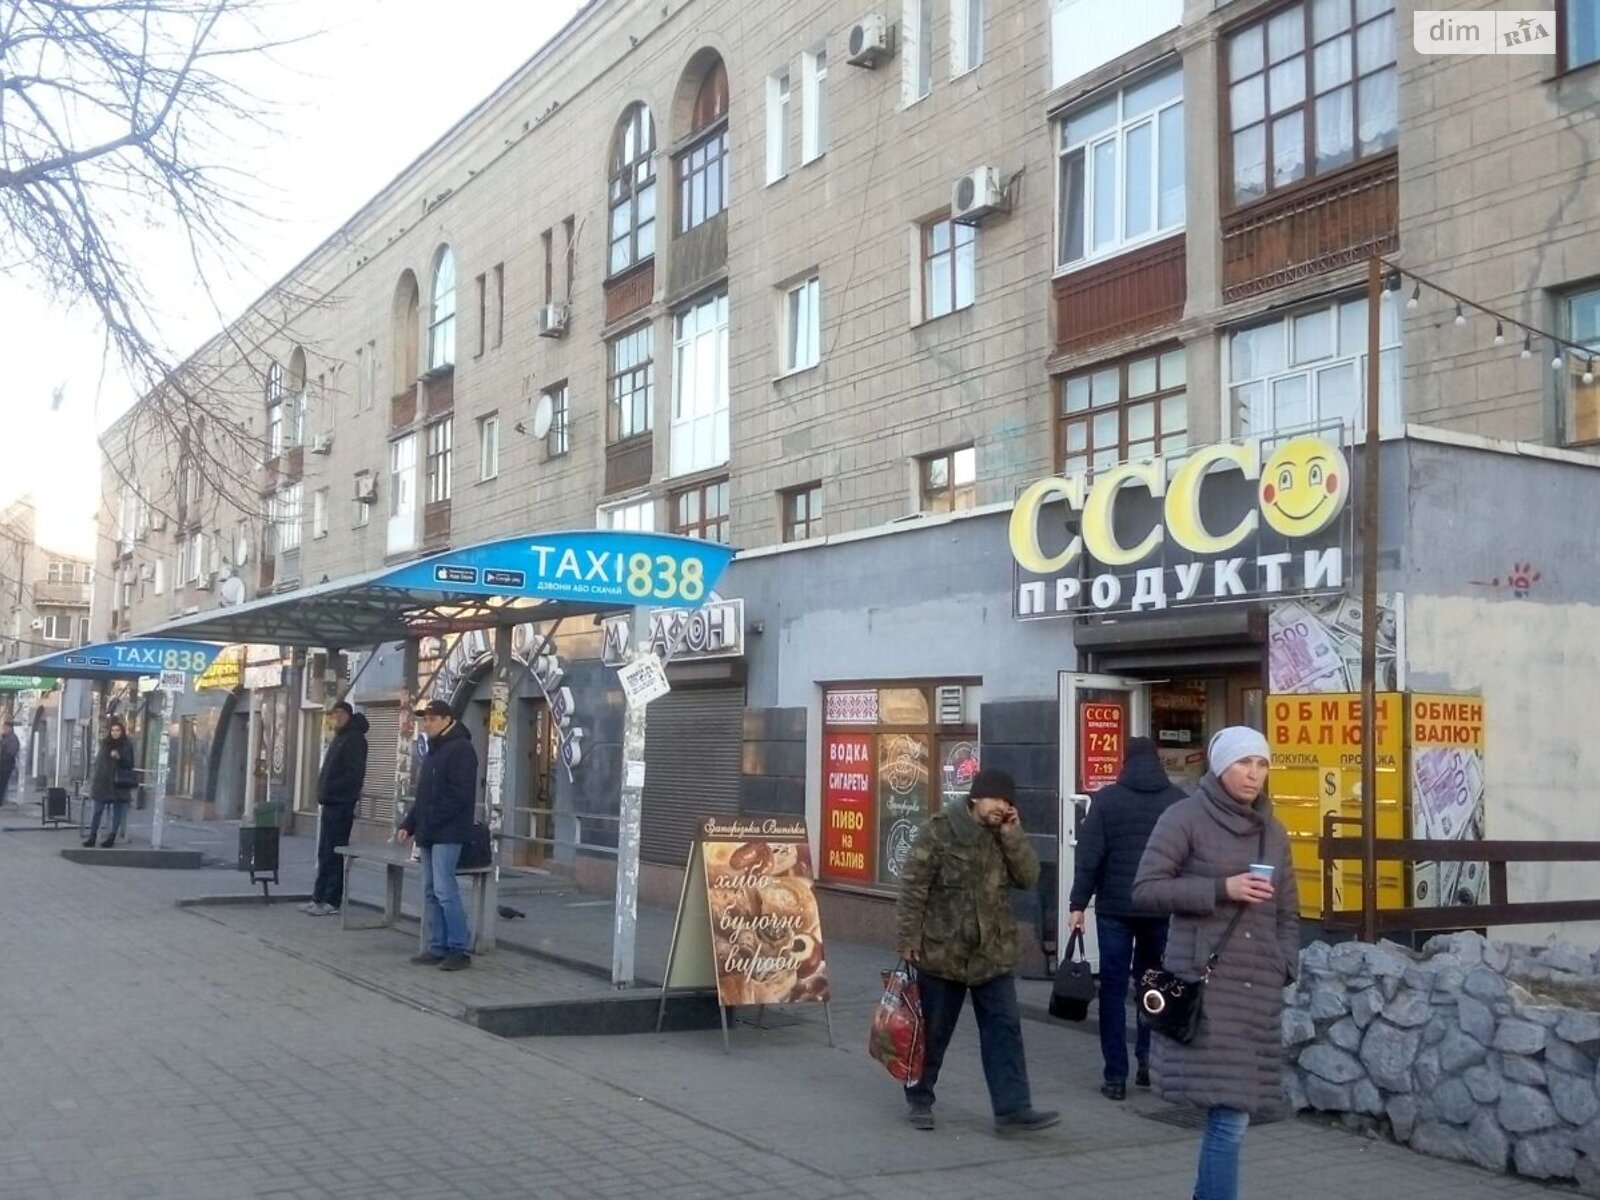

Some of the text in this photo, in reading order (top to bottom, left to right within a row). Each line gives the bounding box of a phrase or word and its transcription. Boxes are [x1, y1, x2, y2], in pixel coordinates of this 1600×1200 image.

[537, 581, 623, 596] ДЗВОНИ АБО СКАЧАЙ
[1018, 547, 1343, 614] ПРОДУКТИ
[1272, 622, 1309, 649] 500
[1275, 700, 1389, 722] ОБМЕН
[1414, 701, 1483, 722] ОБМЕН
[1088, 732, 1119, 752] 7-21
[1275, 725, 1389, 746] ВАЛЮТ
[1414, 725, 1482, 744] ВАЛЮТ
[830, 743, 869, 764] ВОДКА
[1271, 753, 1319, 765] ПОКУПКА
[1340, 753, 1396, 766] ПРОЖА
[1093, 763, 1114, 774] 7-19
[829, 772, 869, 791] СИГАРЕТЫ
[831, 809, 864, 831] ПИВО
[841, 834, 854, 849] на
[829, 850, 865, 870] РАЗЛИВ
[719, 899, 804, 943] булочні
[724, 942, 802, 984] вироби
